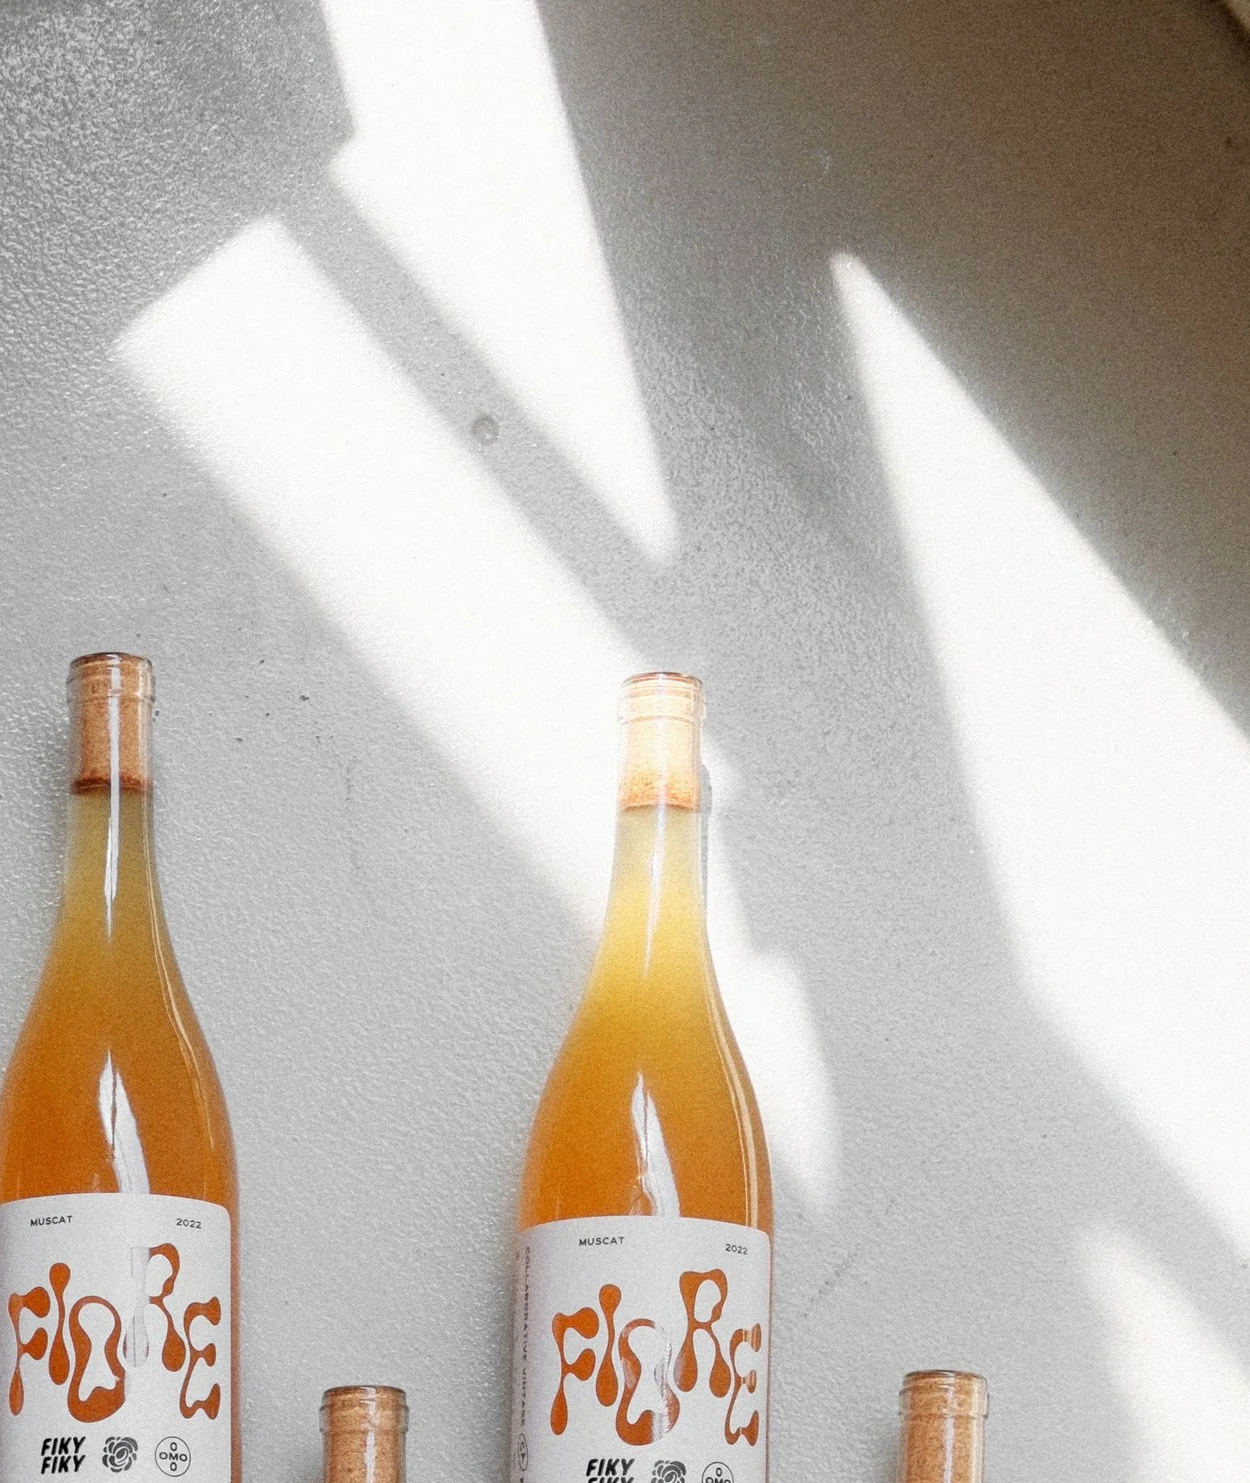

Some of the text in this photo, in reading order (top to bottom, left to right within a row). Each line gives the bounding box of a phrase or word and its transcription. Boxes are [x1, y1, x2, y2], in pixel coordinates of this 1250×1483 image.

[30, 1215, 72, 1226] MUSCAT
[176, 1218, 201, 1229] 2022
[579, 1237, 624, 1246] MUSCAT
[726, 1244, 747, 1255] 2022
[41, 1437, 85, 1456] FIKY
[41, 1455, 85, 1474] FIKY
[586, 1459, 634, 1476] FIKY
